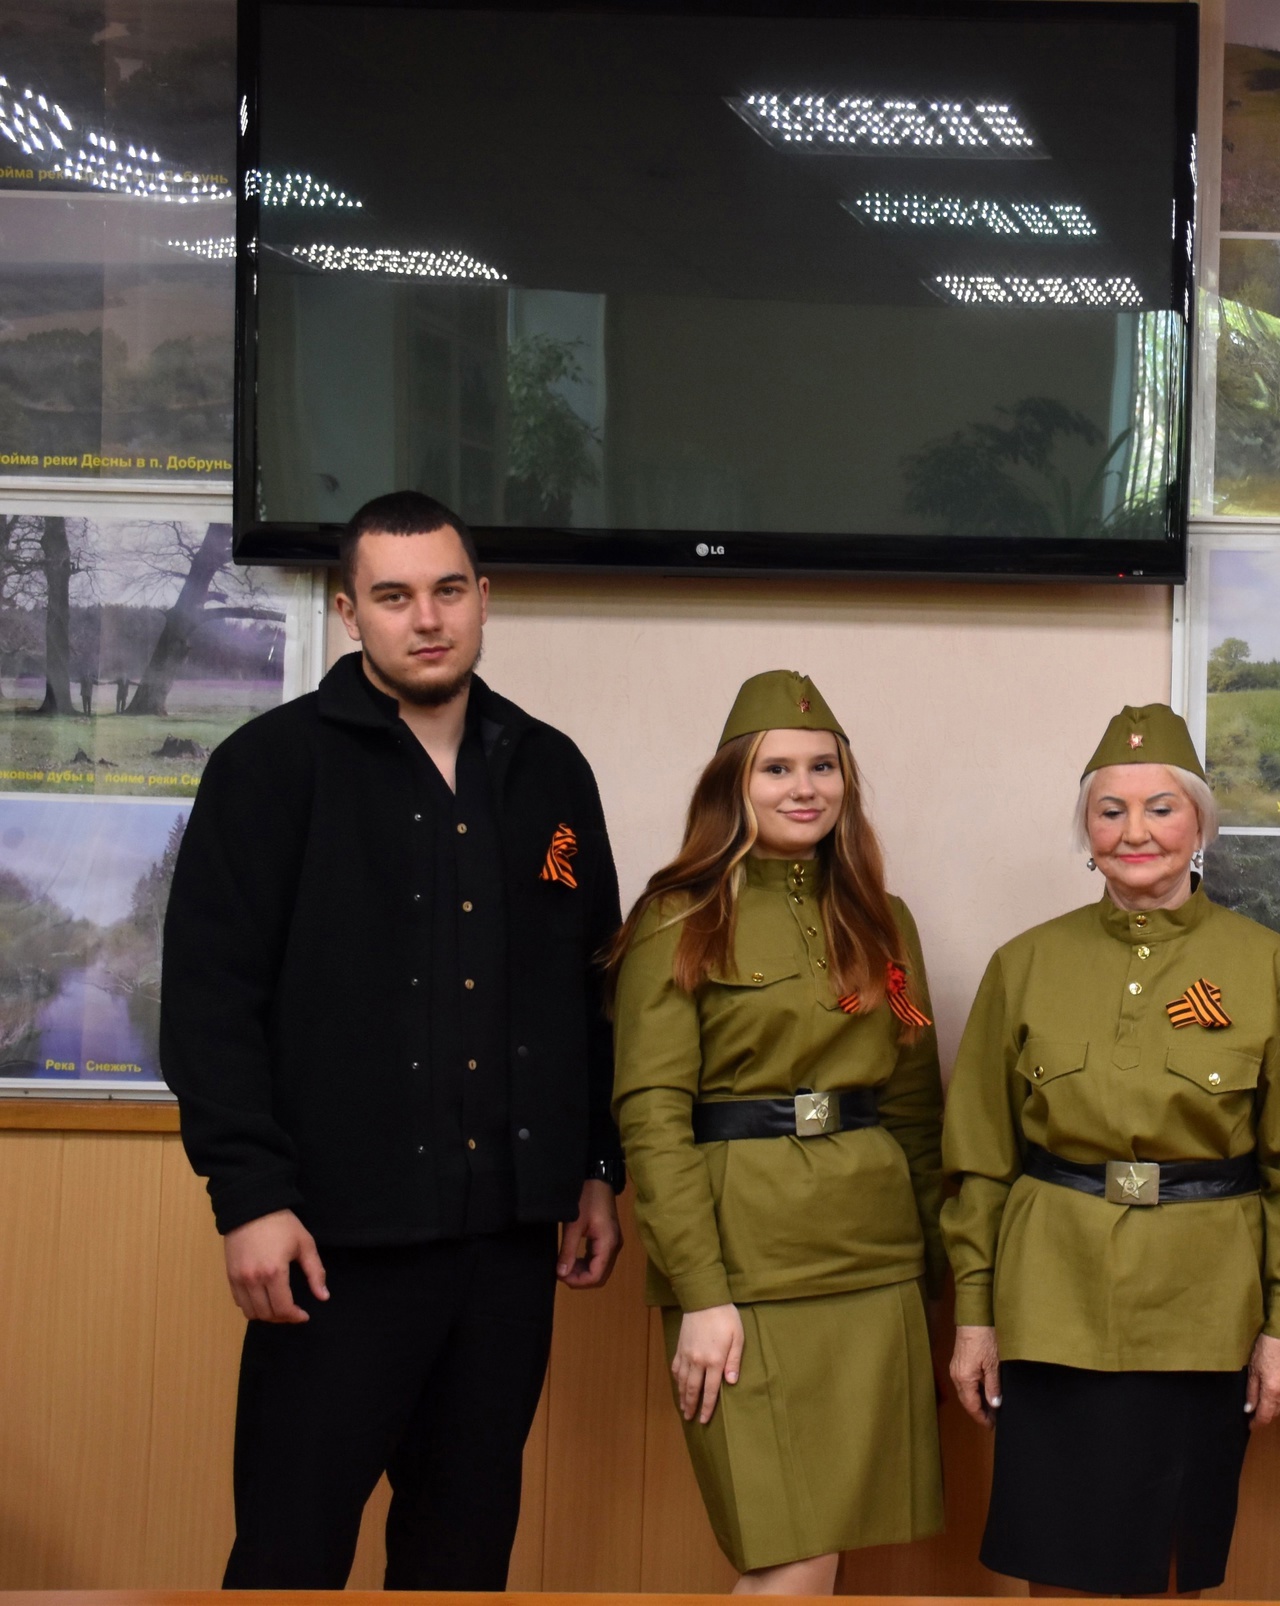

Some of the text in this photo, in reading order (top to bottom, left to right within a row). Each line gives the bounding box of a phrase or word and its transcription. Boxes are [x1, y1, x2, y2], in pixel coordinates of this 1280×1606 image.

[0, 166, 34, 179] ойма
[0, 452, 232, 472] ойма реки Десны в п. Добрунь
[710, 545, 725, 555] LG
[47, 770, 83, 783] дубы
[105, 773, 145, 784] пойме
[148, 775, 178, 786] реки
[45, 1059, 142, 1073] Река Снежеть
